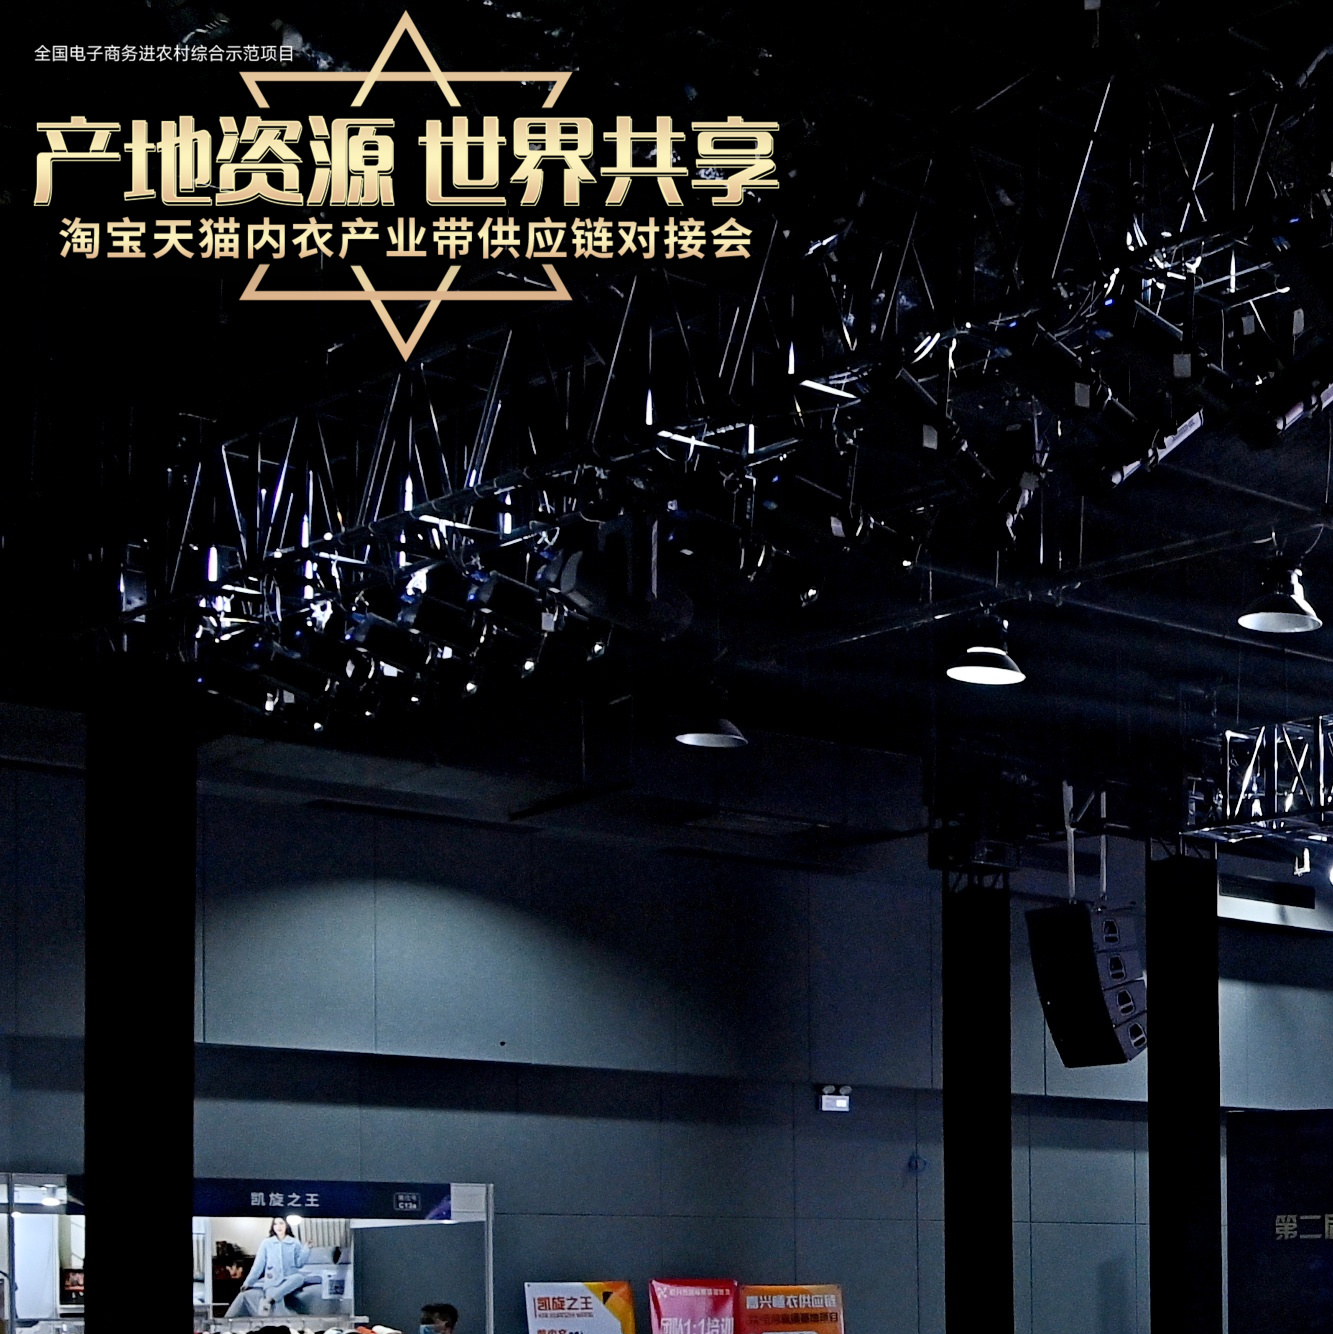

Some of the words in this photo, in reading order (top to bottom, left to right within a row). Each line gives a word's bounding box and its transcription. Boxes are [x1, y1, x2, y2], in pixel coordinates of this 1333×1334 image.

[251, 1192, 320, 1207] 凯旋之王
[537, 1296, 593, 1311] 凯旋之王
